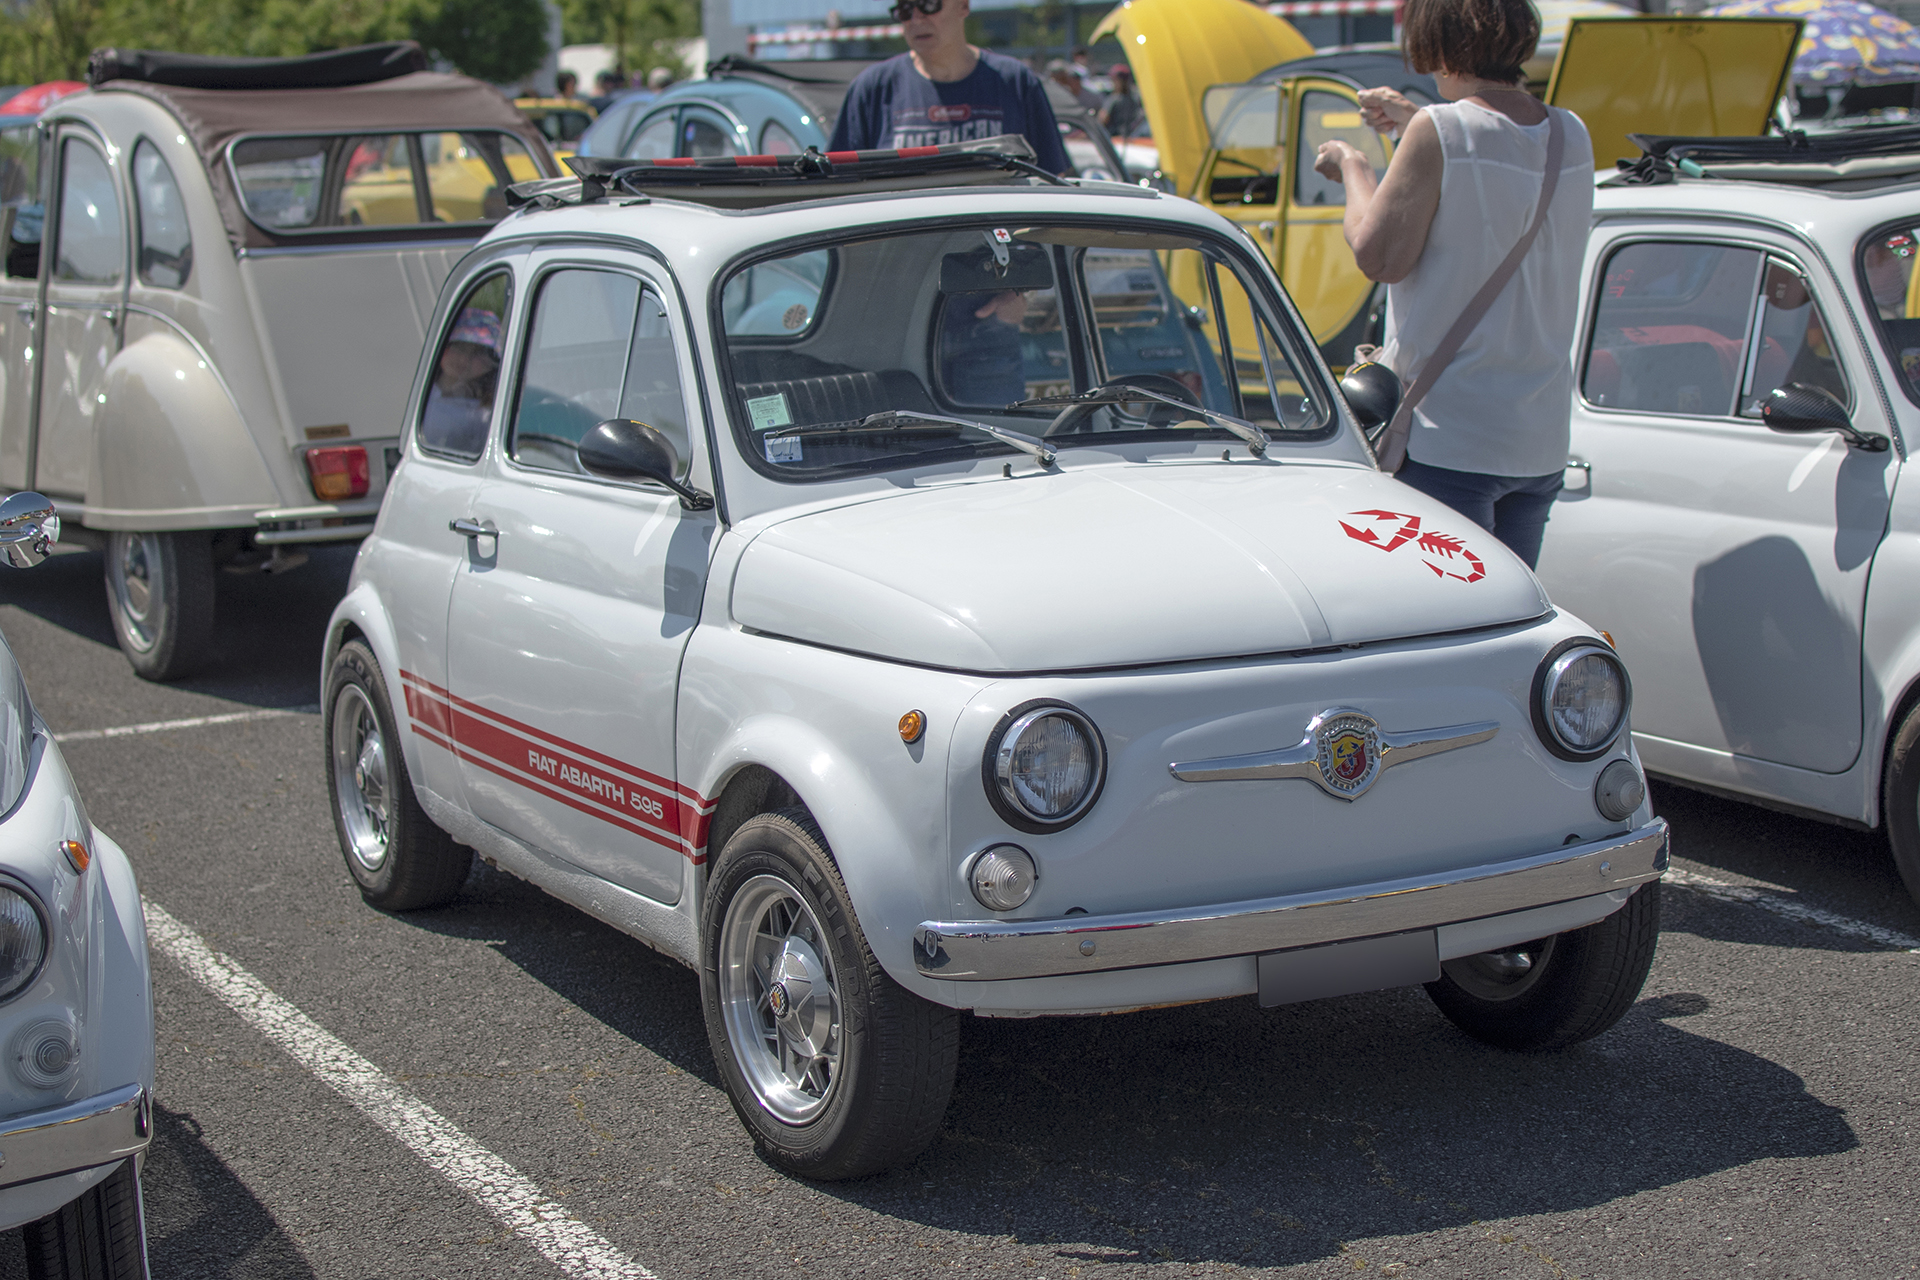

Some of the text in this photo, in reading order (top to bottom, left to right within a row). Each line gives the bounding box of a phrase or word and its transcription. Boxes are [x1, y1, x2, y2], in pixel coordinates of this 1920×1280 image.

[893, 118, 1003, 150] AMERICAN
[528, 750, 663, 819] FIAT ABARTH 595
[802, 861, 865, 1036] FULDA
